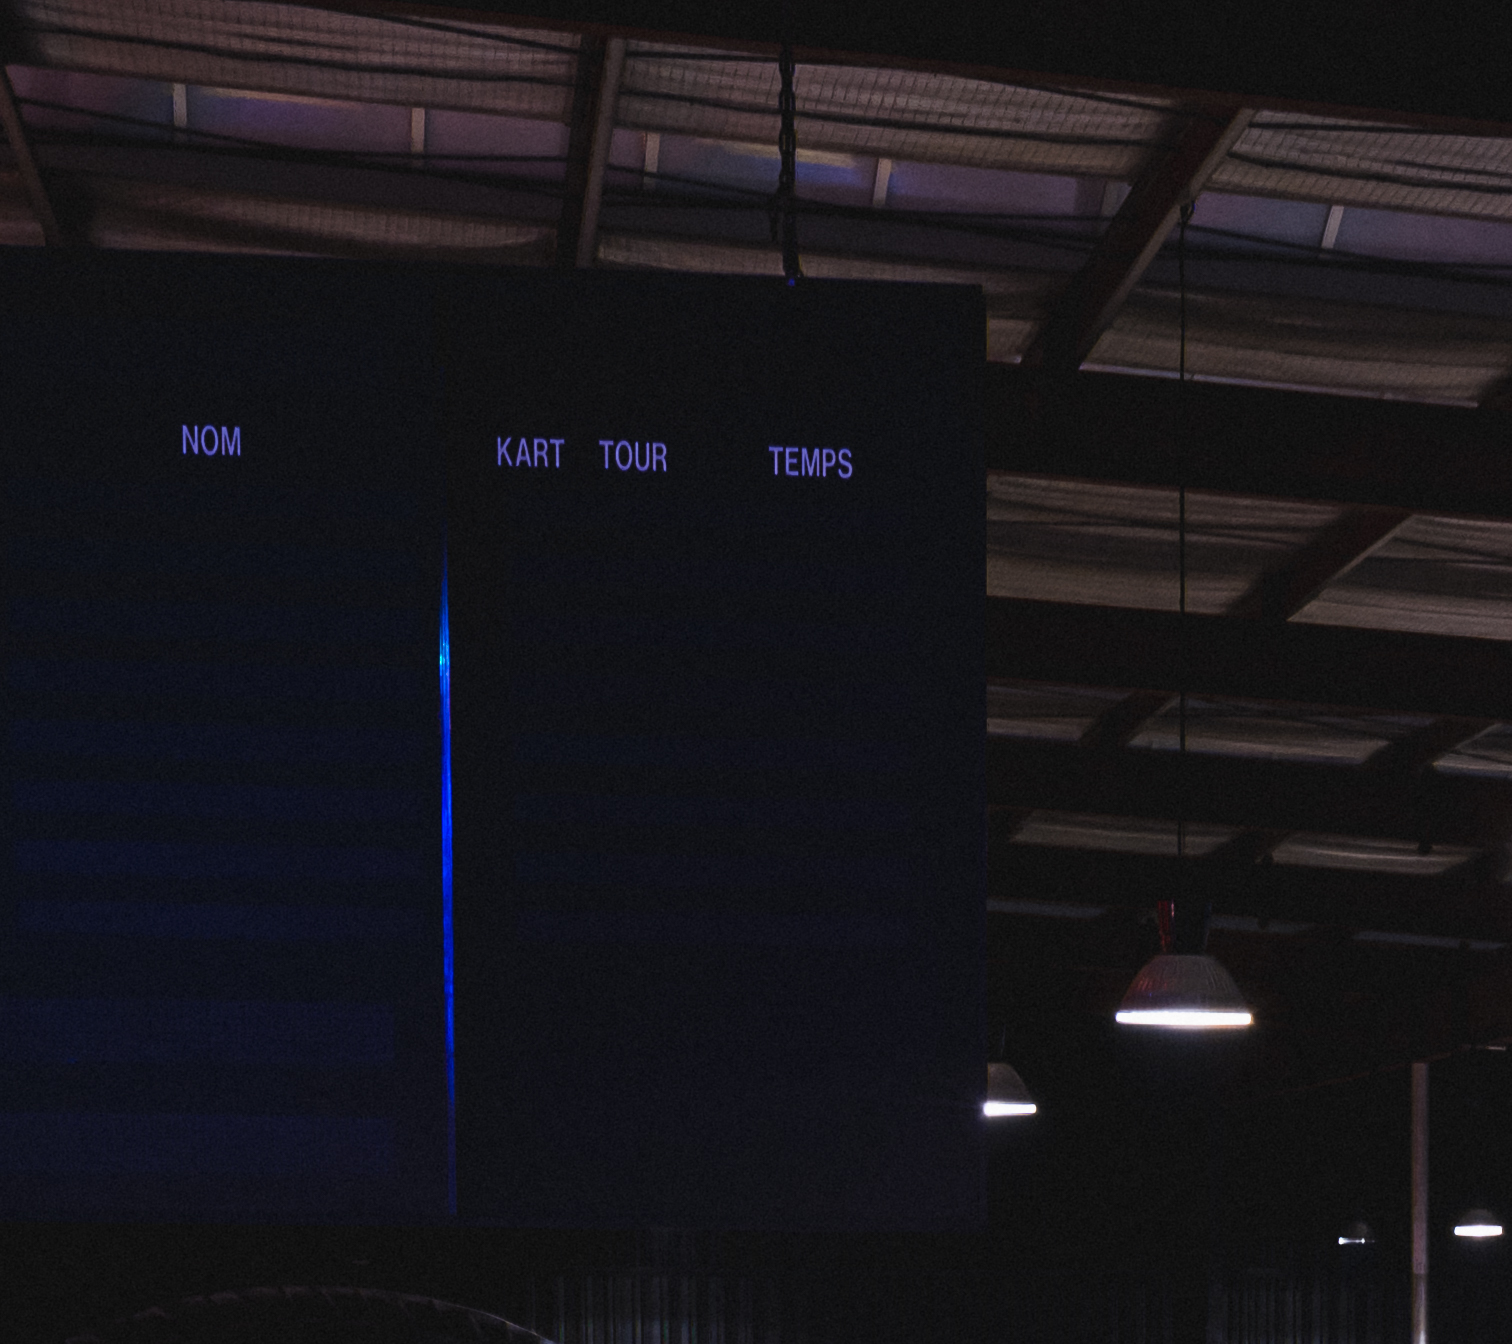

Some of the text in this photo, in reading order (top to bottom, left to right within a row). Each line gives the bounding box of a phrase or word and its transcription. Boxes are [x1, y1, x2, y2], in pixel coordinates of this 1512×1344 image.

[181, 424, 242, 457] NOM
[496, 436, 565, 469] KART
[598, 439, 668, 473] TOUR
[768, 445, 854, 479] TEMPS
